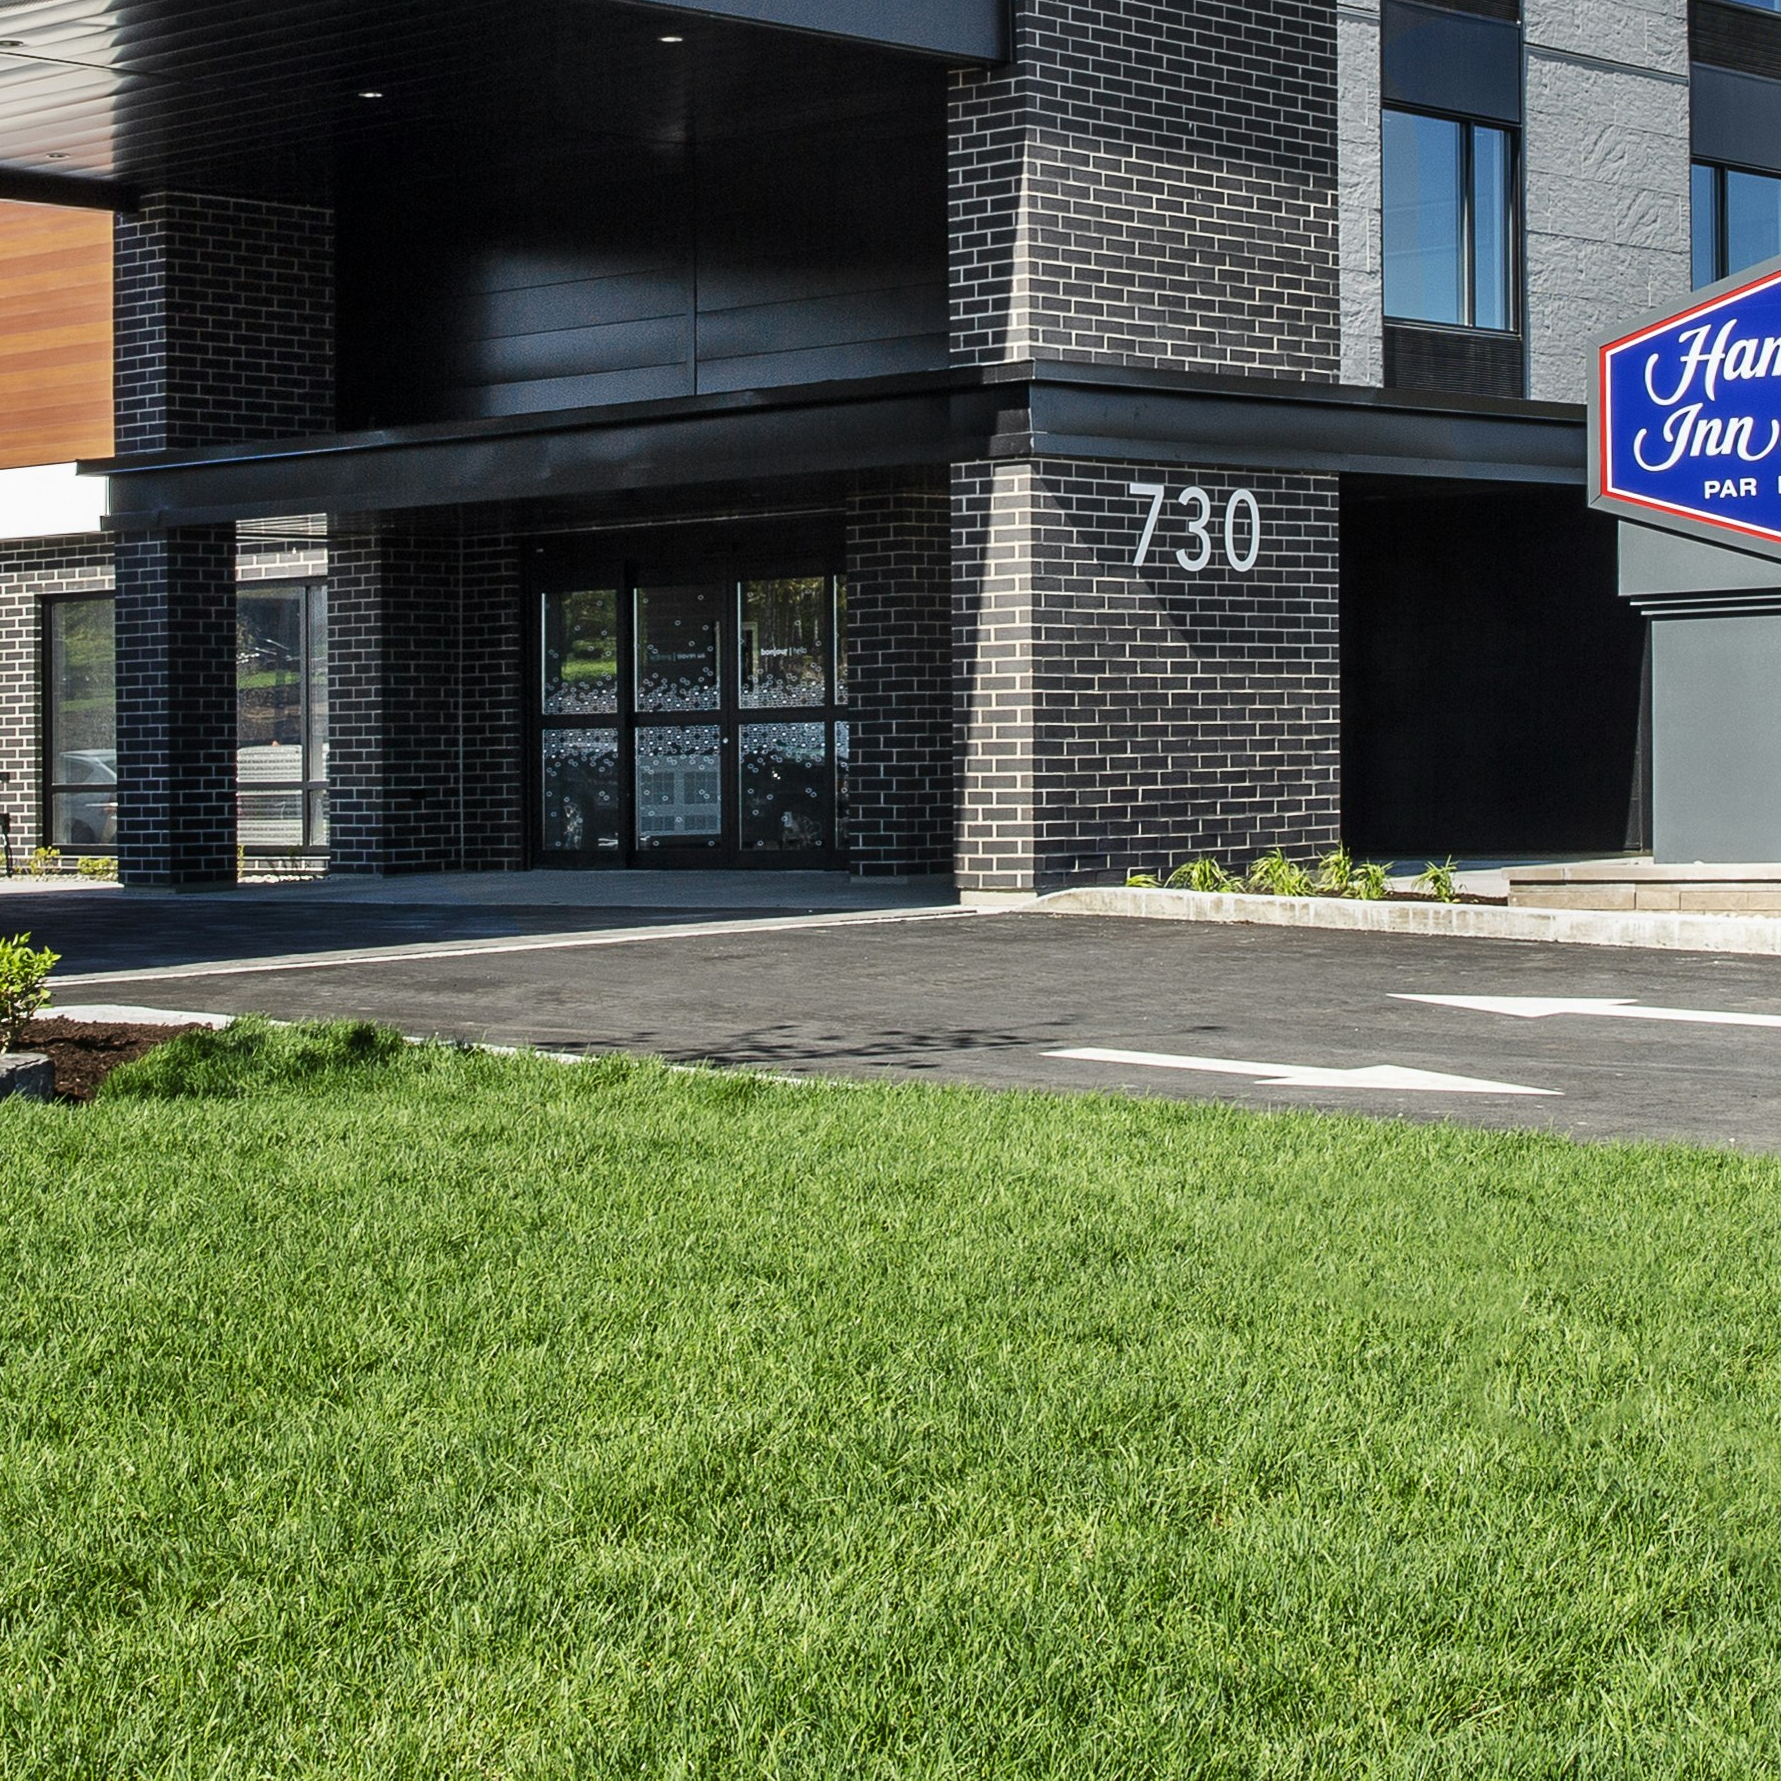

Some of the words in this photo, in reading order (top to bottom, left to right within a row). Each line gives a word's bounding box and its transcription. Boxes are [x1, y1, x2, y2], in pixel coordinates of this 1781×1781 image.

[1633, 402, 1780, 472] Inn
[1704, 477, 1758, 499] PAR
[1129, 482, 1261, 573] 730
[760, 647, 788, 657] bonjour
